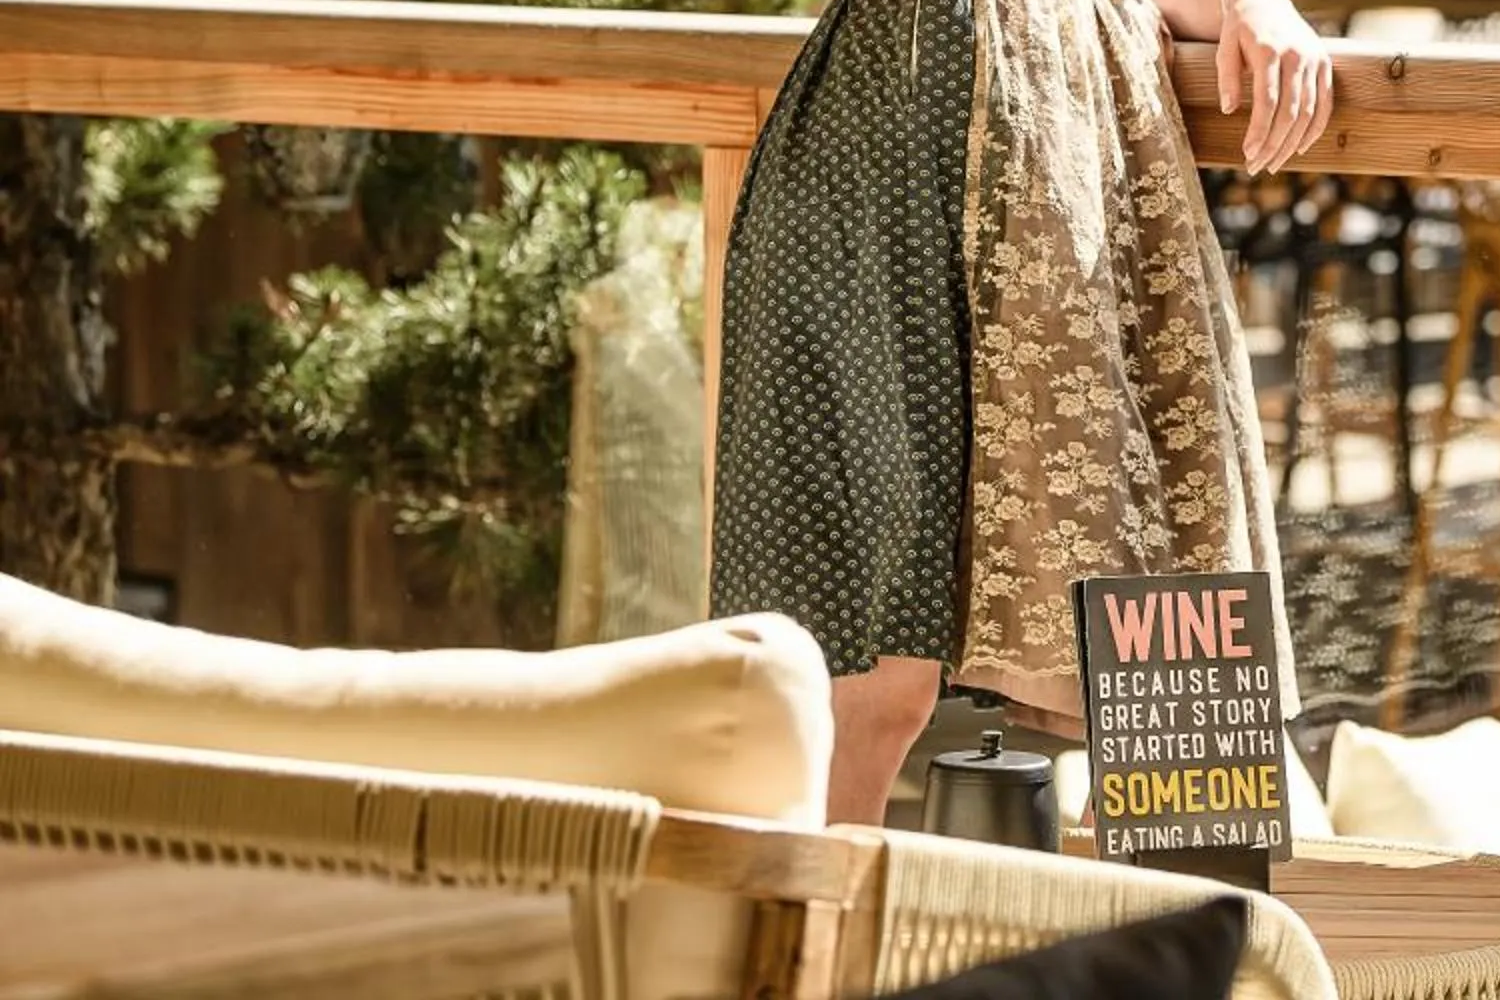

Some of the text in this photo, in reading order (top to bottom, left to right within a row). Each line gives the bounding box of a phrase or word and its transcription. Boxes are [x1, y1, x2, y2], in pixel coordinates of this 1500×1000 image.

[1104, 590, 1252, 663] WINE
[1099, 665, 1270, 699] BECAUSE NO
[1100, 698, 1272, 731] GREAT STORY
[1102, 730, 1276, 763] STARTED WITH
[1103, 765, 1281, 817] SOMEONE
[1107, 820, 1283, 855] EATING A SALAD
